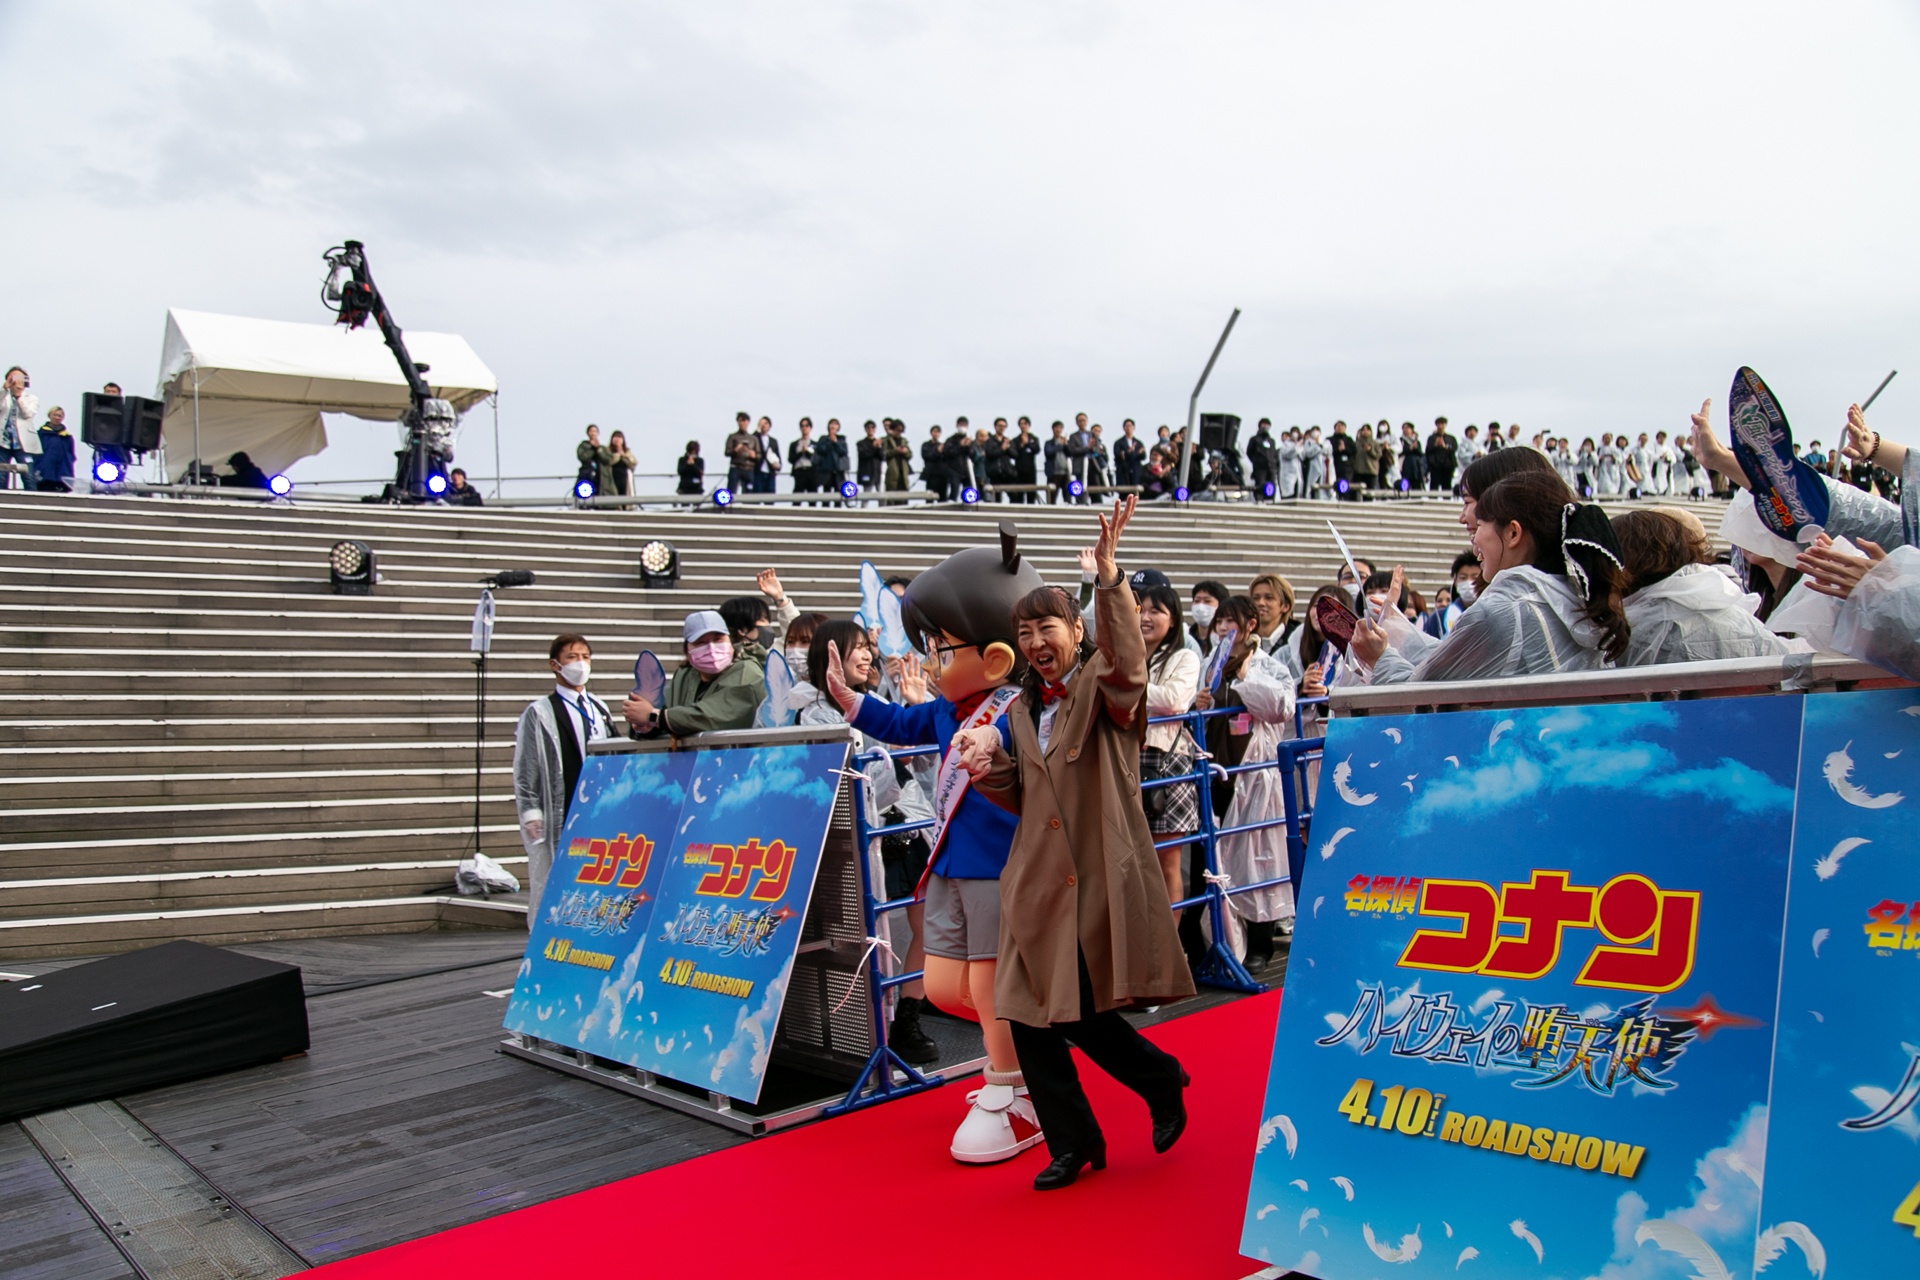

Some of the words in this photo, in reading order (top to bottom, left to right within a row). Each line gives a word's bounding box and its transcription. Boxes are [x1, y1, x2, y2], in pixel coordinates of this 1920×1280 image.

[659, 957, 693, 986] 4.10
[690, 971, 754, 998] ROADSHOW
[1317, 987, 1678, 1096] ハイウェイの堕天使
[1338, 1078, 1432, 1135] 4.10
[1440, 1111, 1646, 1178] ROADSHOW
